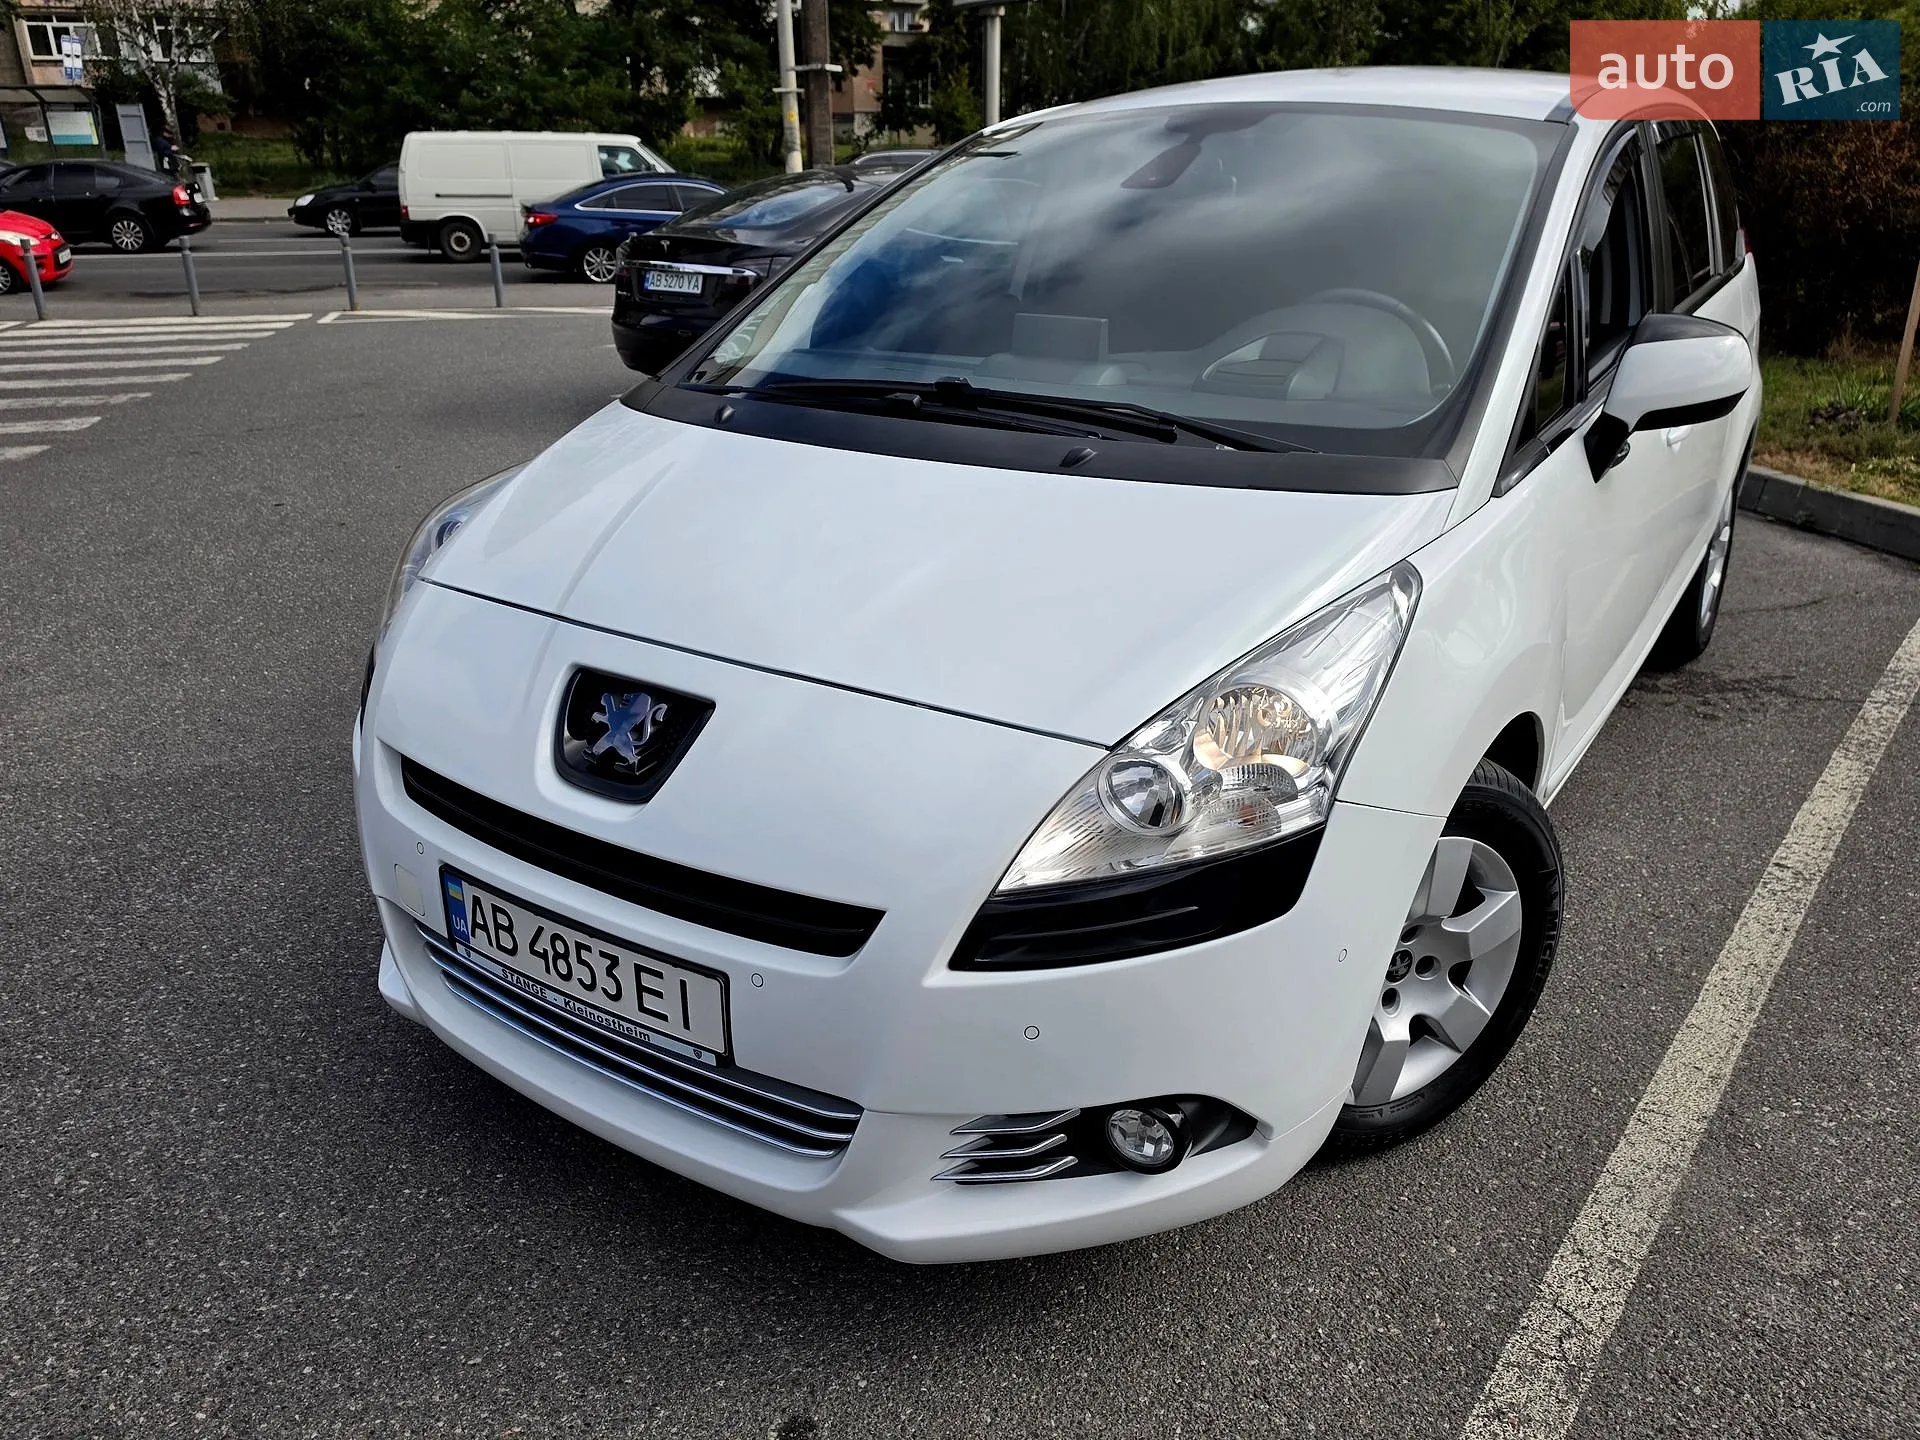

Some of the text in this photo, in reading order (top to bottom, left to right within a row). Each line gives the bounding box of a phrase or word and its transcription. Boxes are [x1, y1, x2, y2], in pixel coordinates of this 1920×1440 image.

[650, 273, 661, 287] AB
[663, 274, 684, 289] 5270
[688, 275, 699, 290] YA
[452, 914, 468, 935] UA
[470, 895, 691, 1031] AB 4853 EI
[501, 968, 548, 999] STANGE
[563, 998, 651, 1042] Kleinostheim
